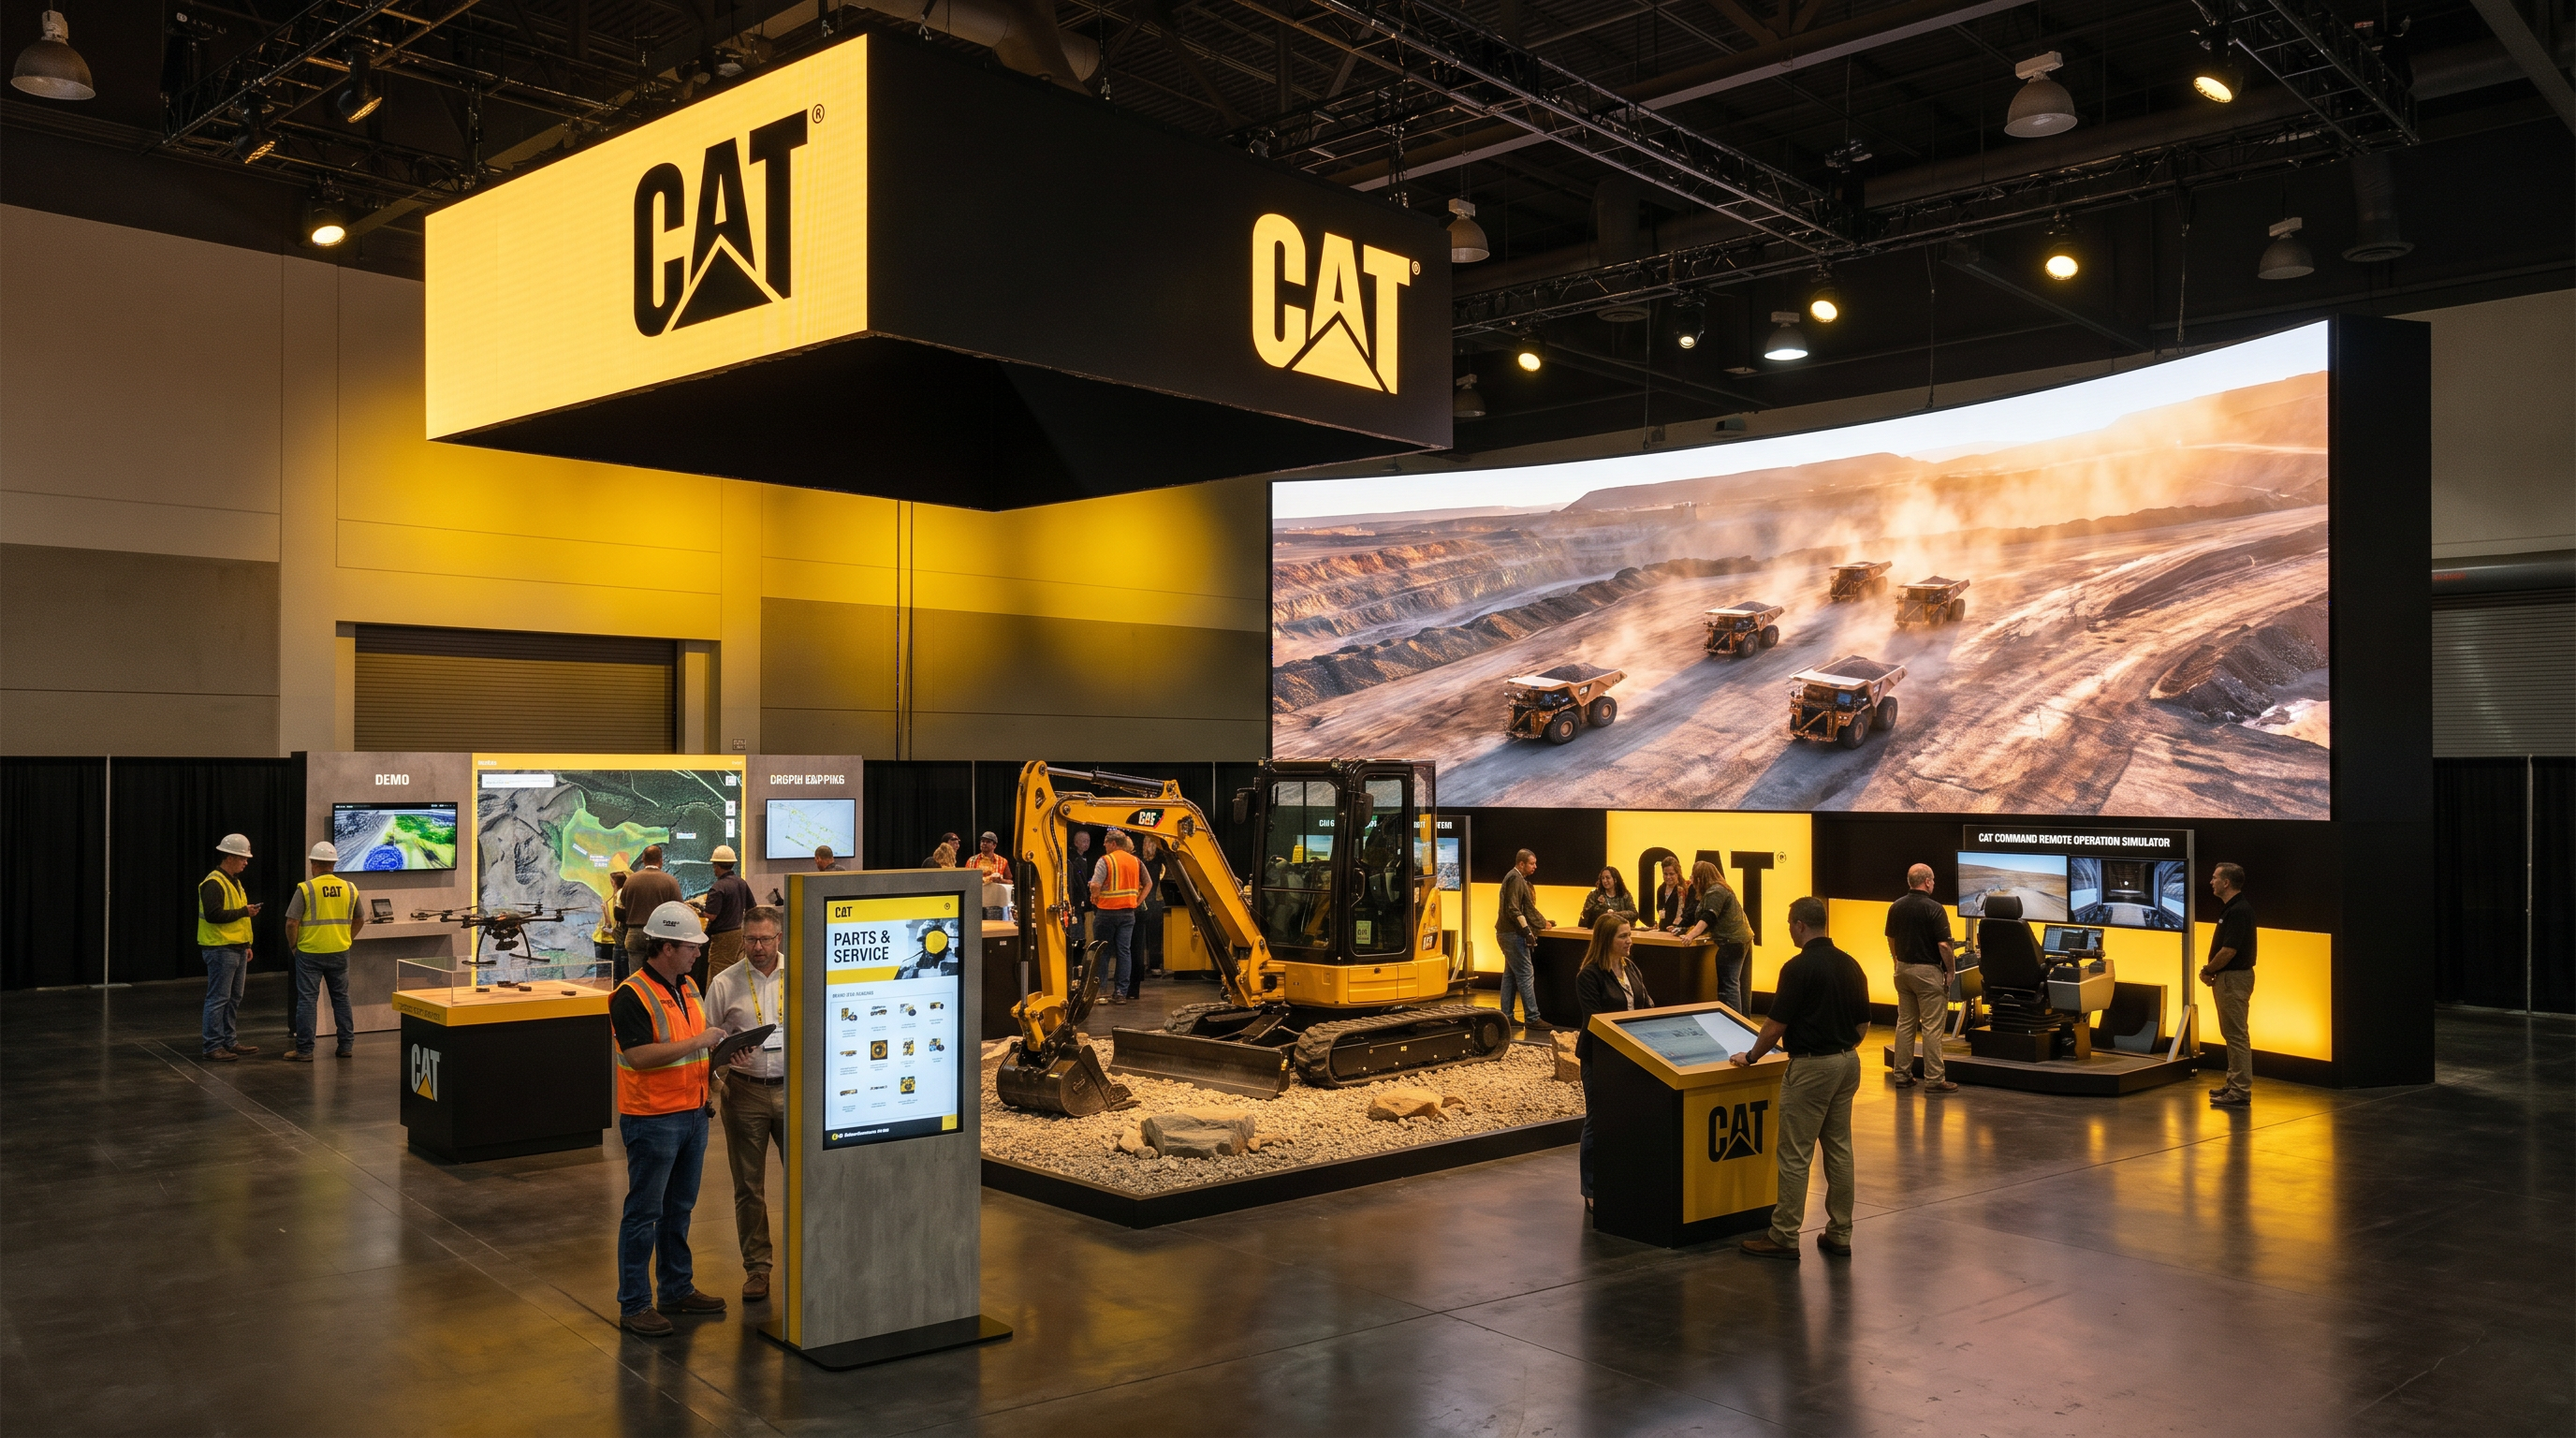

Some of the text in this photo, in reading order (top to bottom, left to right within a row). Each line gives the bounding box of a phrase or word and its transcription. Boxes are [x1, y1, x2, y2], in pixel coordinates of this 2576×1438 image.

[375, 774, 410, 785] DEMO
[1978, 833, 2171, 847] CAT COMMAND REMOTE OPERATION SIMULATOR
[322, 886, 343, 898] CAT
[834, 930, 891, 946] PARTS &
[834, 946, 889, 963] SERVICE
[411, 1043, 441, 1103] CAT
[1708, 1099, 1768, 1163] CAT
